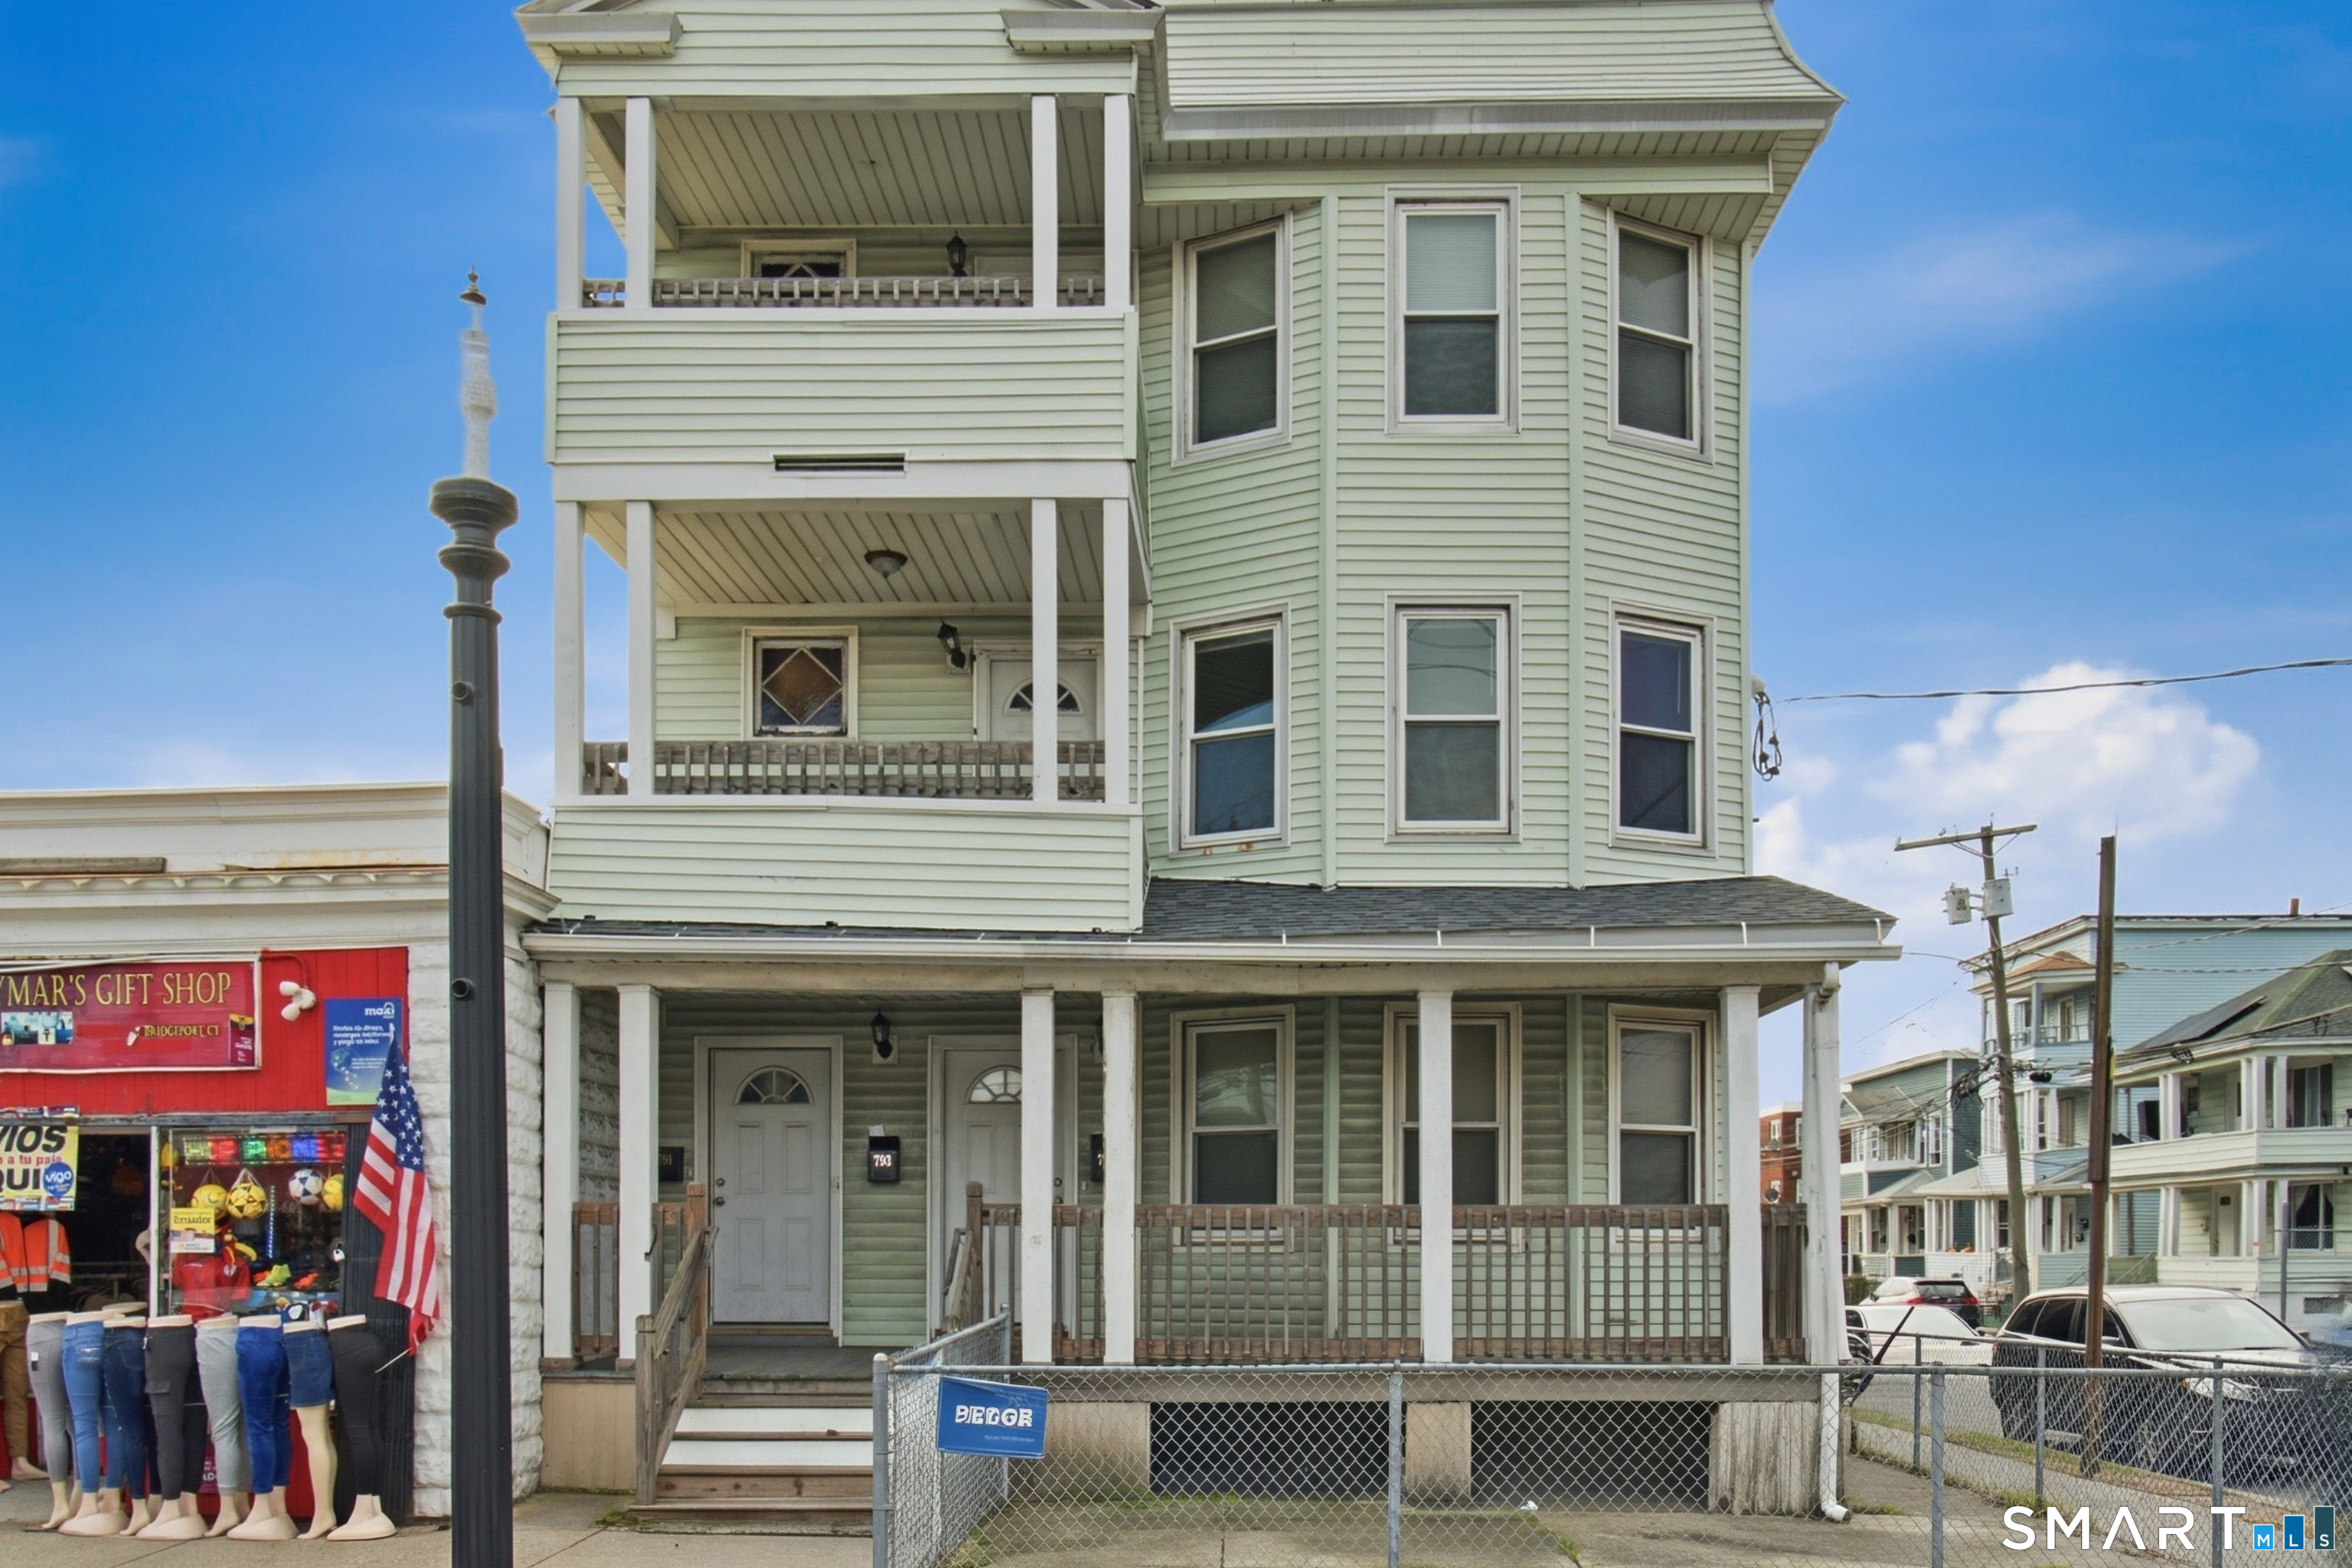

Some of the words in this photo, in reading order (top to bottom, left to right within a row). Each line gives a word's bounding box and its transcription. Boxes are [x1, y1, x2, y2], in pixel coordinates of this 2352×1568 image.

[95, 973, 153, 1005] GIFT
[162, 972, 231, 1004] SHOP
[874, 1155, 892, 1167] 793
[0, 1168, 40, 1192] UI
